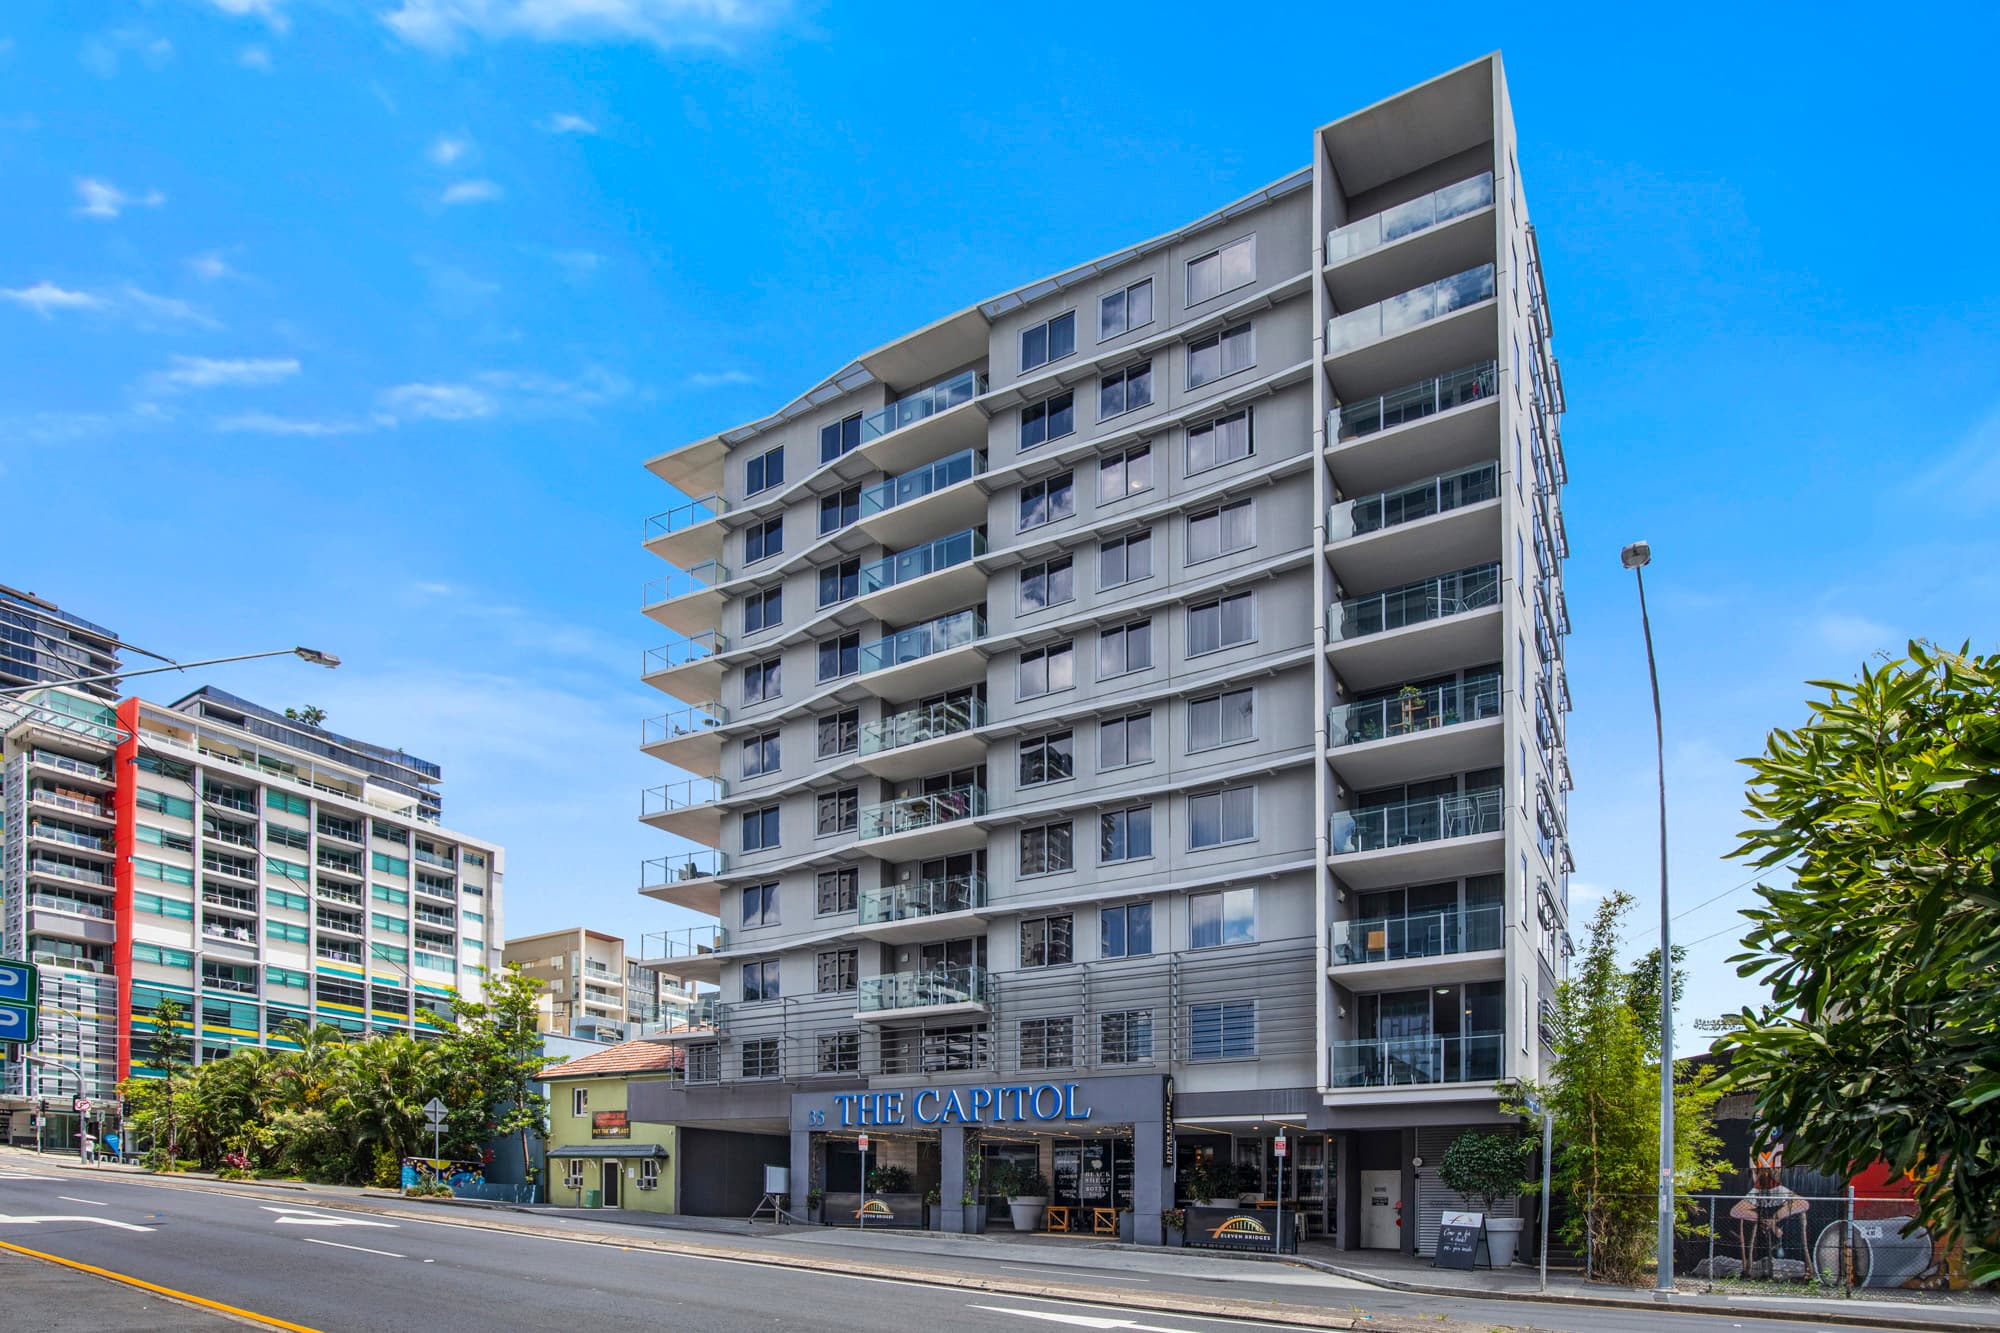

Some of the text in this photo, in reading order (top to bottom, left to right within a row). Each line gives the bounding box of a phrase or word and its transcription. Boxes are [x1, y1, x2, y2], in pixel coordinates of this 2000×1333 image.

[808, 1083, 1092, 1127] 35 THE CAPITOL
